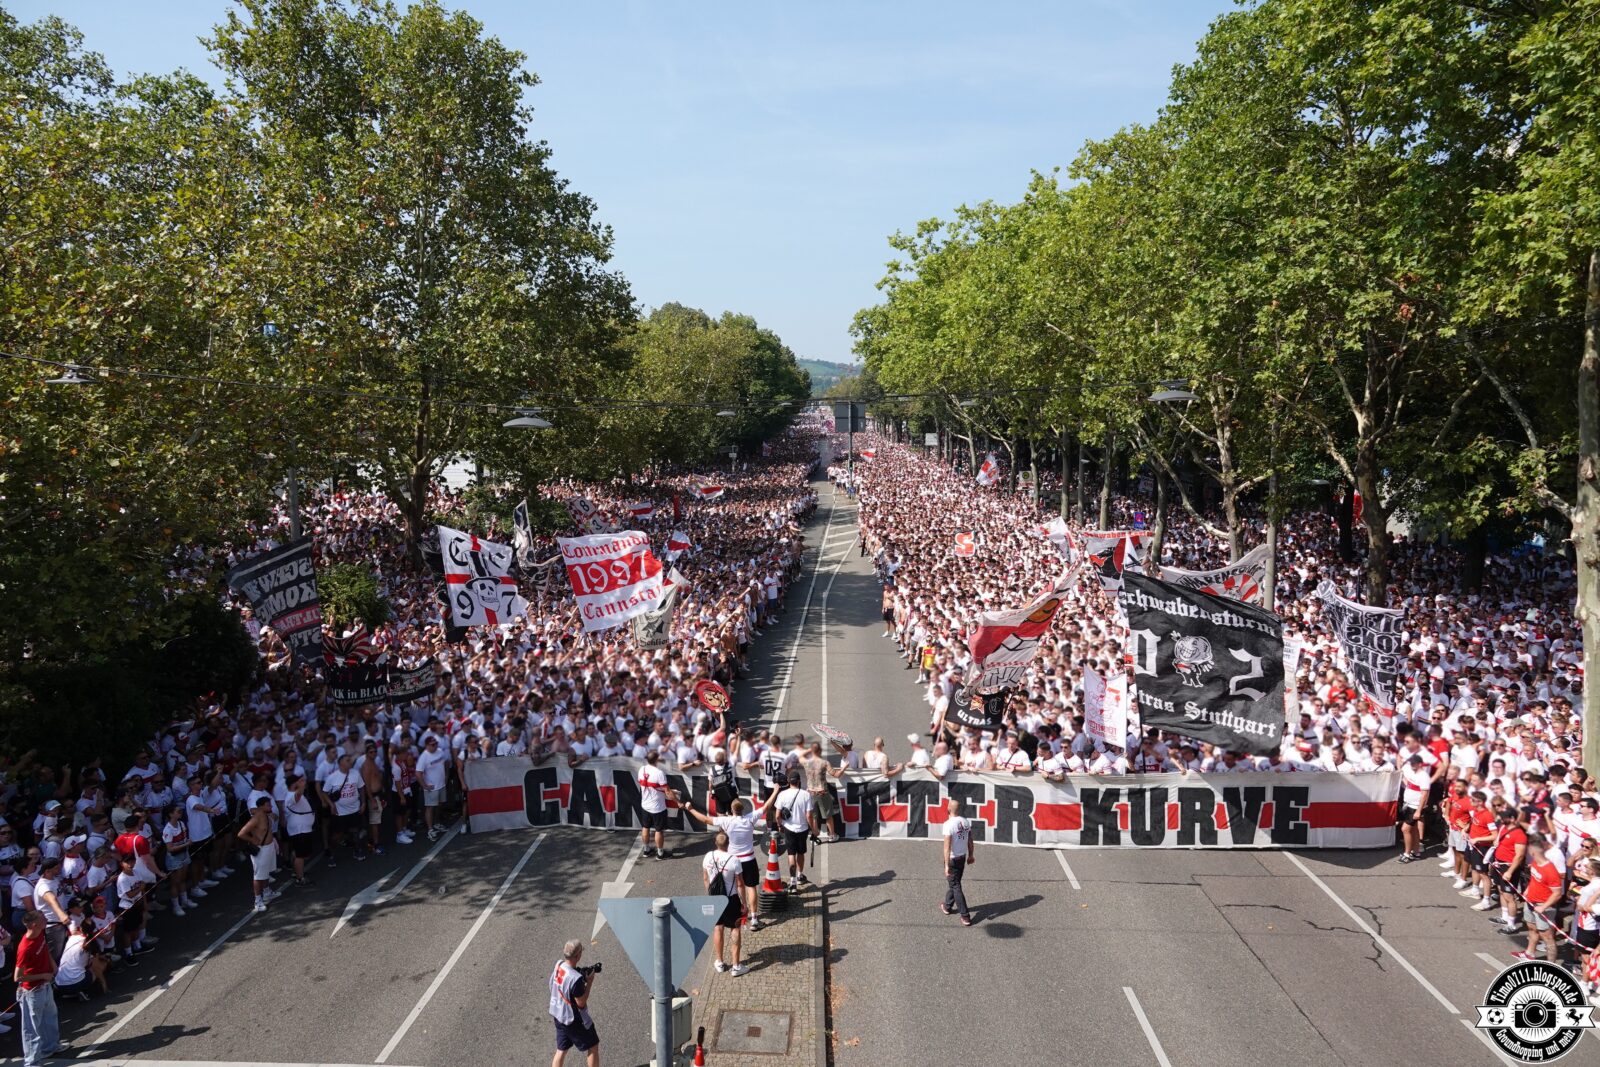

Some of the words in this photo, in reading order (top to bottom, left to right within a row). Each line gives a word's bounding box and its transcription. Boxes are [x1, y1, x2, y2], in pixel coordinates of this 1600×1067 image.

[572, 550, 650, 594] 1997
[456, 590, 475, 620] 9
[501, 591, 516, 617] 7
[957, 709, 992, 726] ULTRAS
[1184, 701, 1277, 738] Stuttgart
[1079, 785, 1309, 847] KURVE
